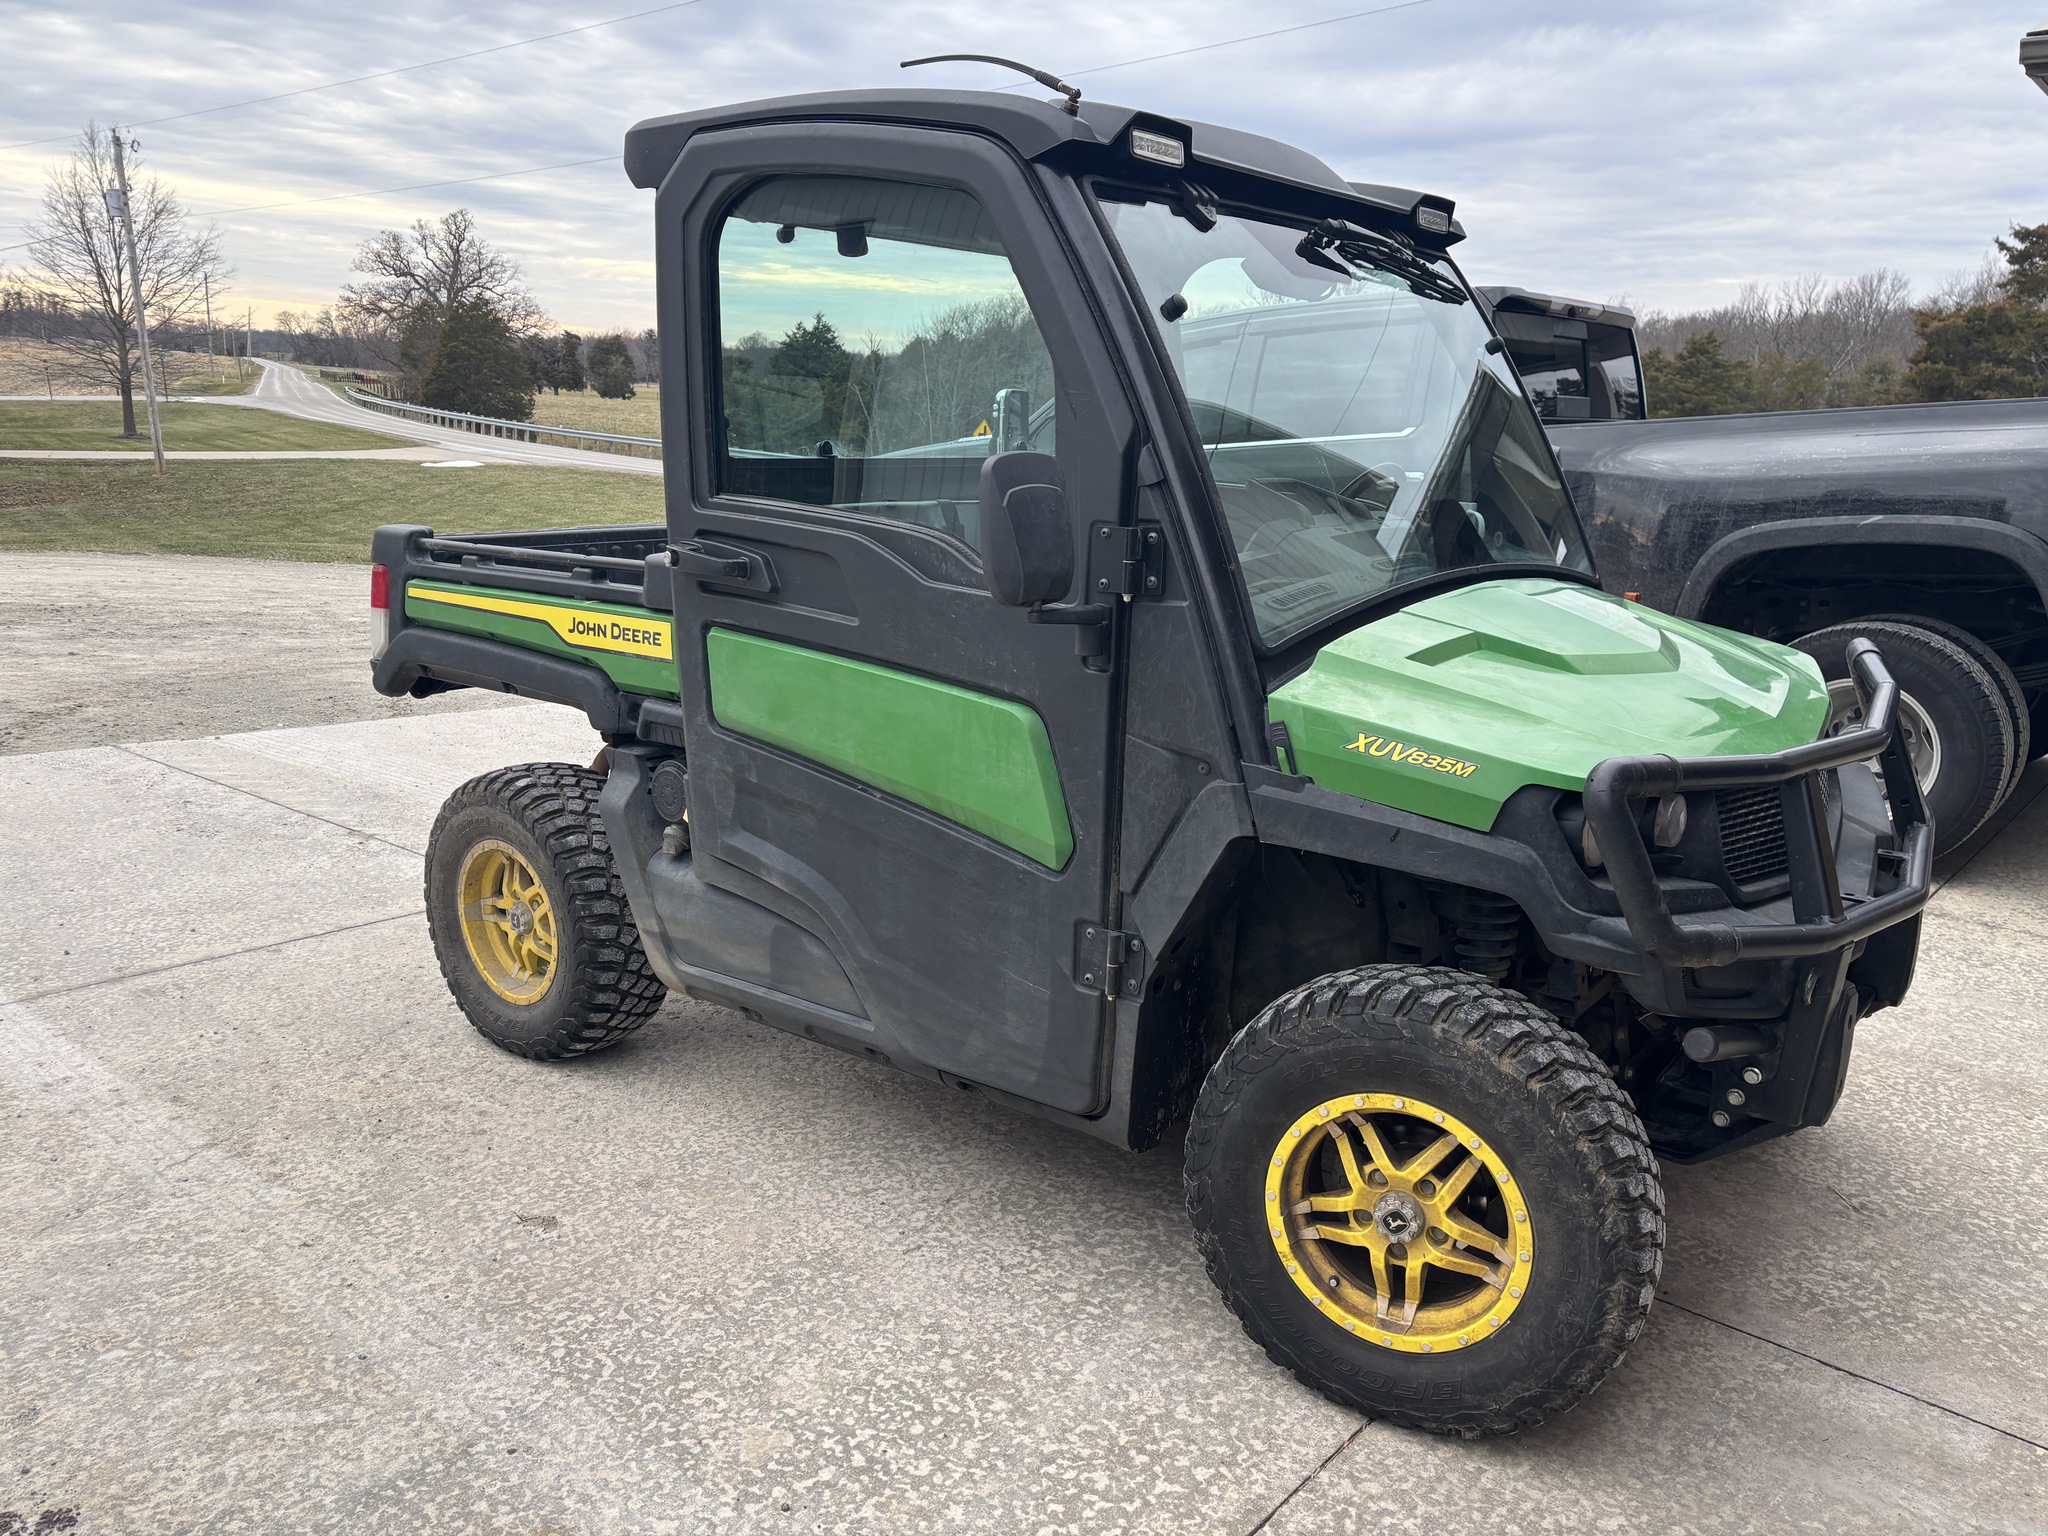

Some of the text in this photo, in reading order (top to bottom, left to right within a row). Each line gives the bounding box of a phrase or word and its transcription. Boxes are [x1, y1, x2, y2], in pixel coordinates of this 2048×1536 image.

[568, 617, 662, 647] JOHN DEERE
[1344, 732, 1478, 778] XUV835M
